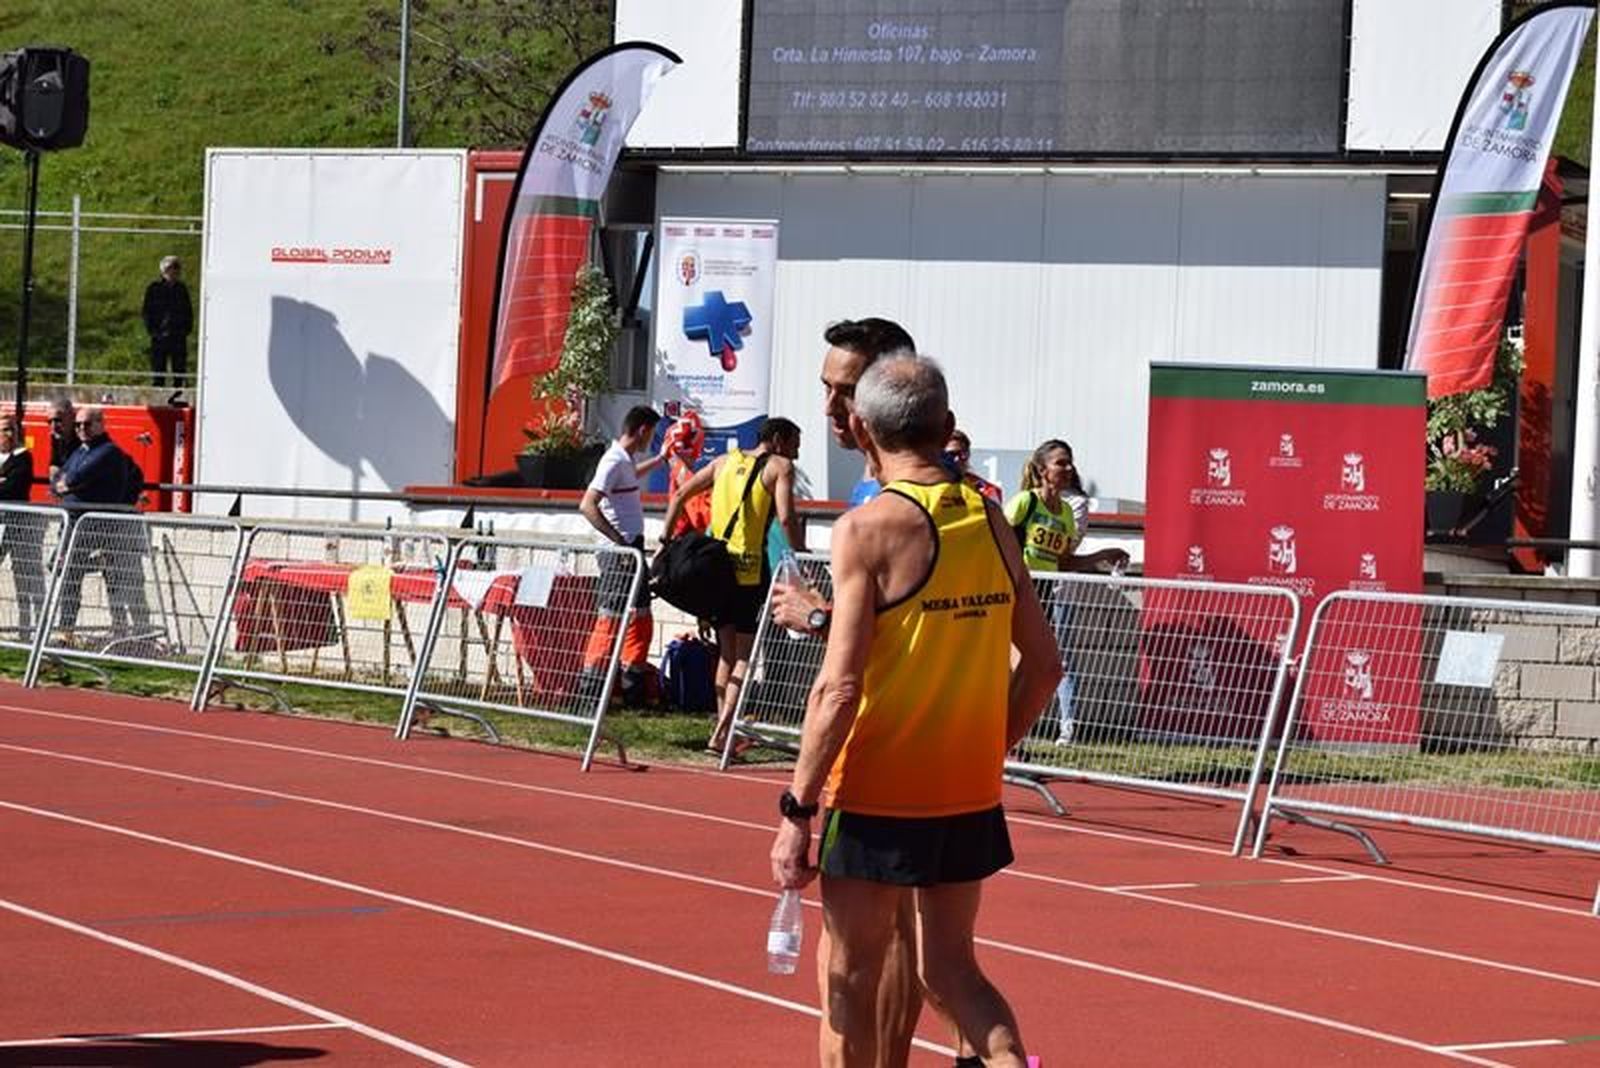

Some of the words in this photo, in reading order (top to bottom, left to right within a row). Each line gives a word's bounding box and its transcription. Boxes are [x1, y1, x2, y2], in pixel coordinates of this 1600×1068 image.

[810, 47, 829, 63] La
[978, 45, 1037, 63] Zamora
[1482, 139, 1537, 162] ZAMORA
[333, 249, 392, 258] PODIUM
[1250, 380, 1326, 394] zamora.es
[1204, 496, 1247, 507] ZAMORA
[1322, 501, 1336, 510] DE
[1338, 501, 1381, 511] ZAMORA
[1033, 527, 1064, 551] 316
[921, 597, 959, 612] MESA
[1340, 711, 1391, 723] ZAMORA
